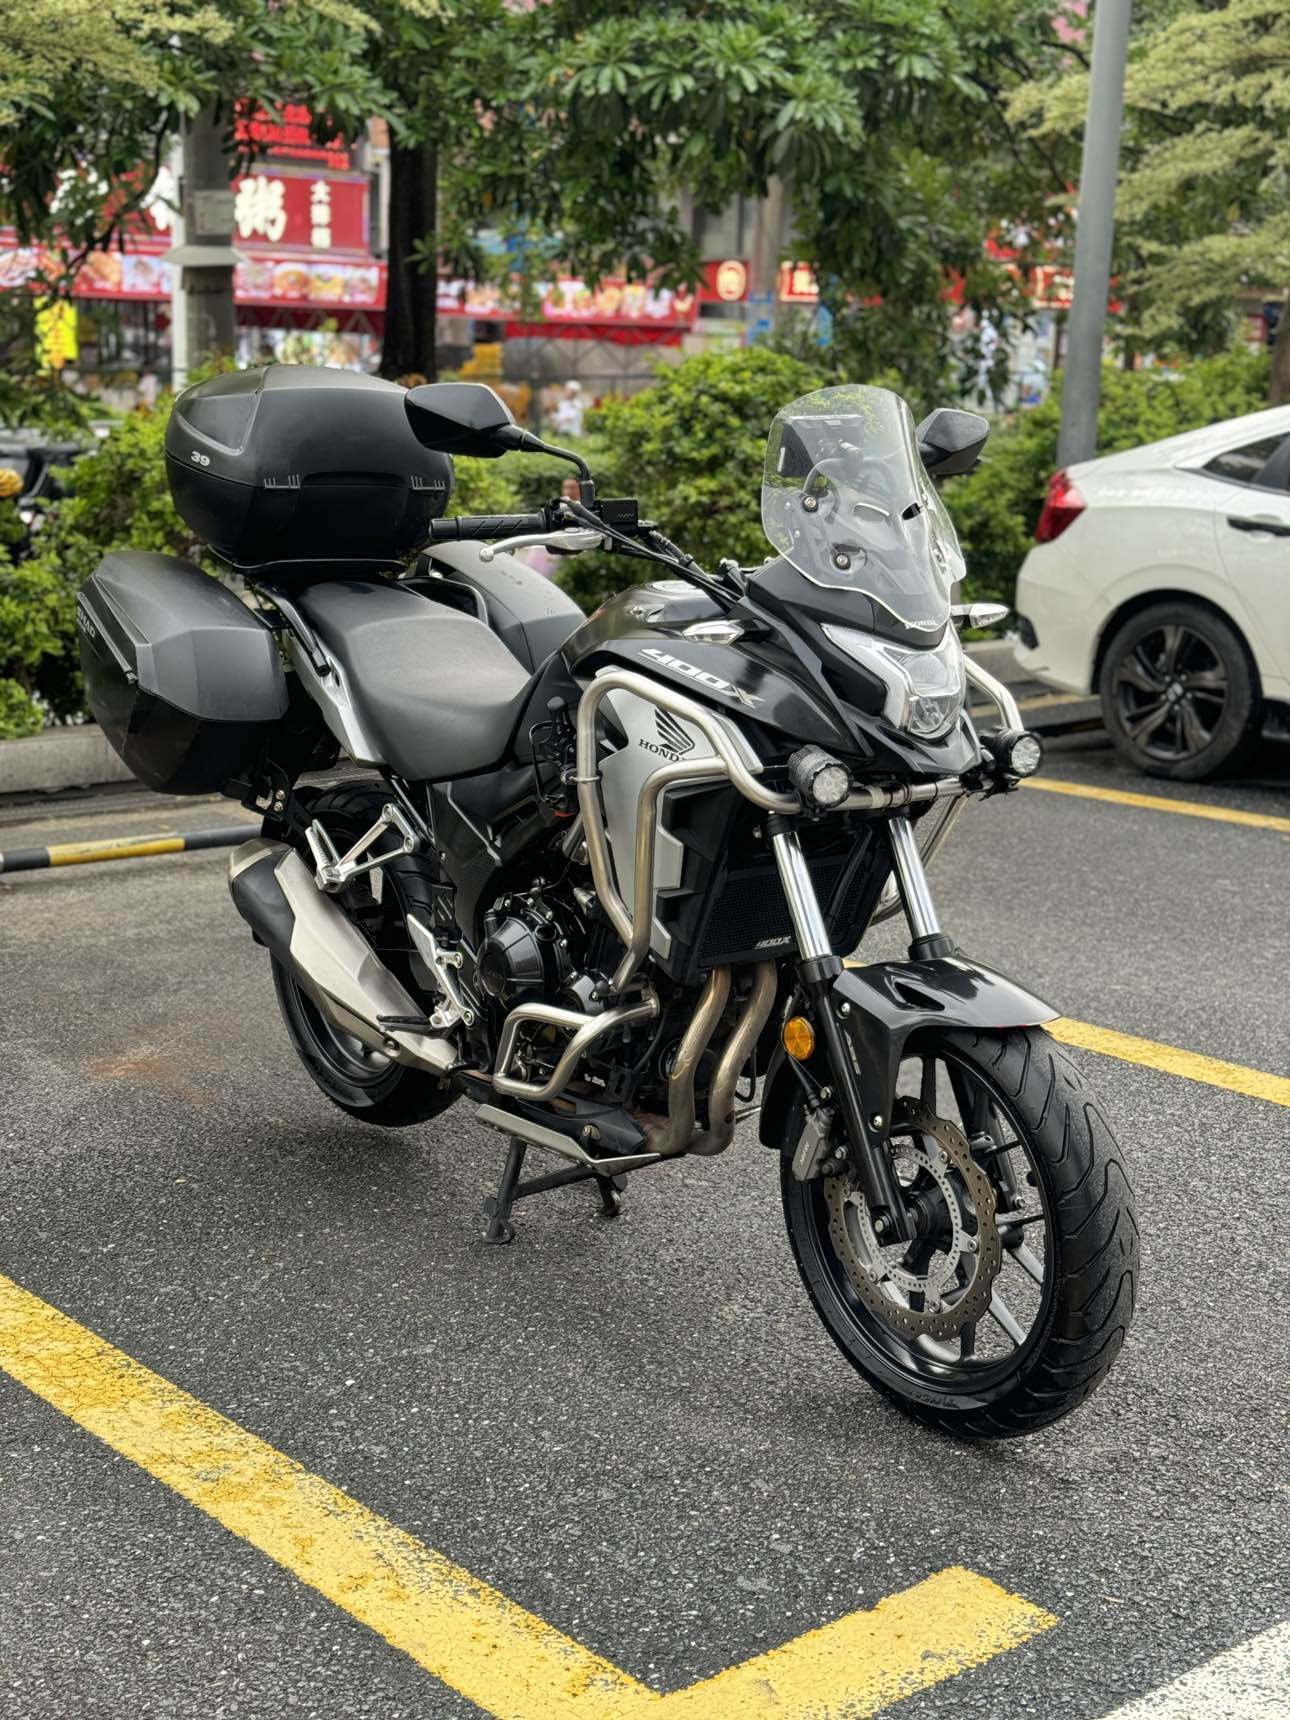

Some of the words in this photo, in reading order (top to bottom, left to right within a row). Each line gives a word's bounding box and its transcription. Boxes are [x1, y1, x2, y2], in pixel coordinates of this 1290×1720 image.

[191, 450, 210, 466] 39
[638, 649, 767, 709] 400X
[638, 738, 686, 763] HOND
[753, 935, 792, 949] 400X
